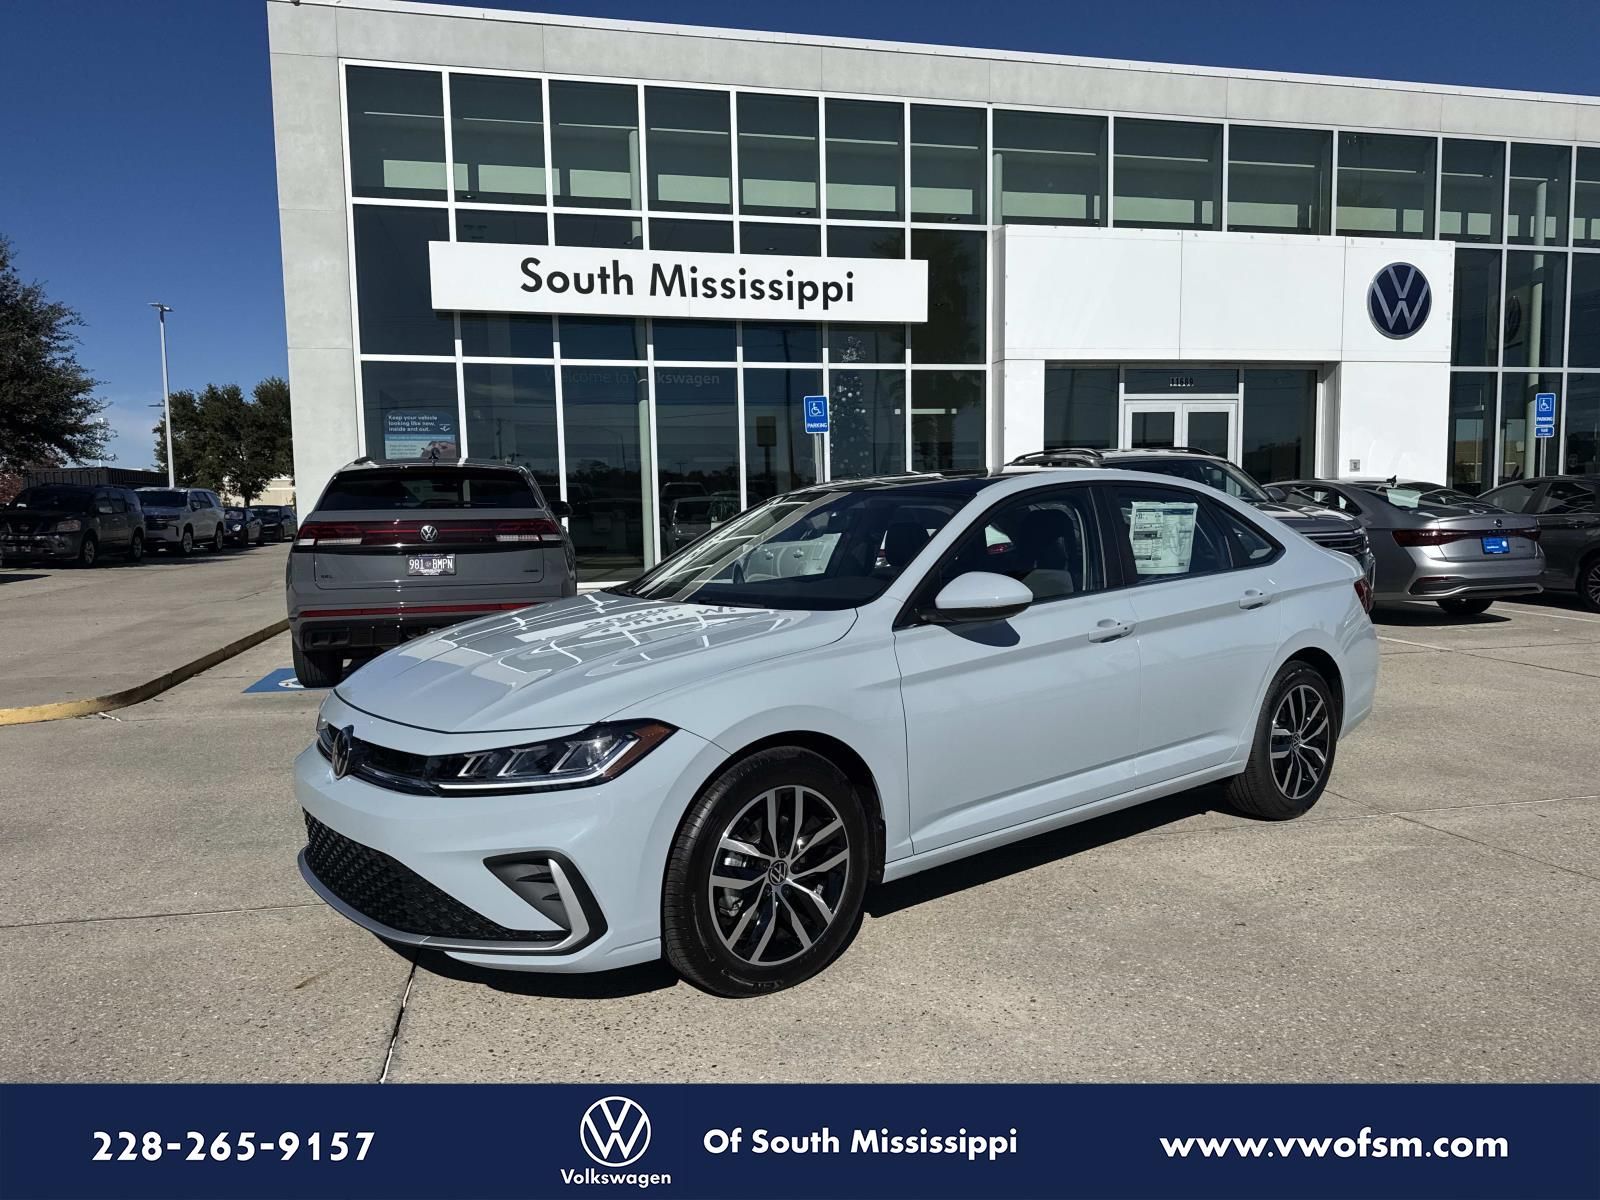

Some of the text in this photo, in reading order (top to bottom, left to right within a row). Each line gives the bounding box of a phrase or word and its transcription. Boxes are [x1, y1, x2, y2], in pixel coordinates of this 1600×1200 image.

[520, 256, 855, 310] South Mississippi
[1369, 263, 1431, 336] VW
[420, 525, 438, 542] VW
[409, 559, 424, 570] 981
